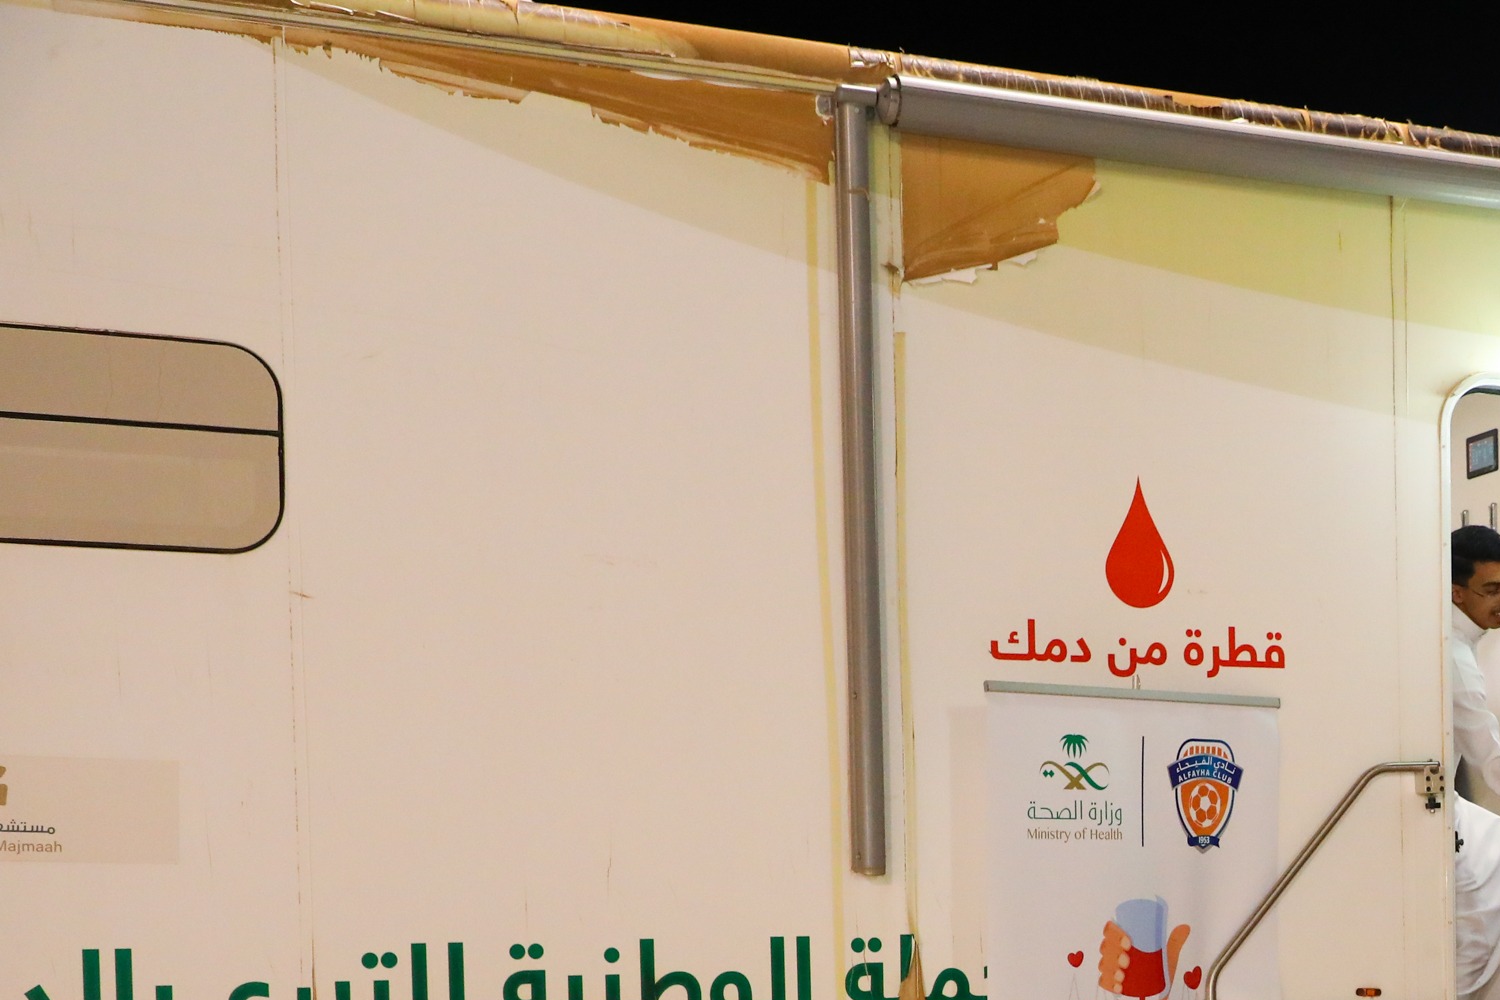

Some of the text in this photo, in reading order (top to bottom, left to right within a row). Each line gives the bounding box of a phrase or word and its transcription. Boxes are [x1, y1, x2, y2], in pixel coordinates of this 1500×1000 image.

[990, 619, 1285, 678] قطرة من دمك
[1178, 769, 1232, 785] ALFAYHA CLUB
[1028, 800, 1122, 826] وزارة الصحة
[1027, 827, 1123, 844] Ministry of Health
